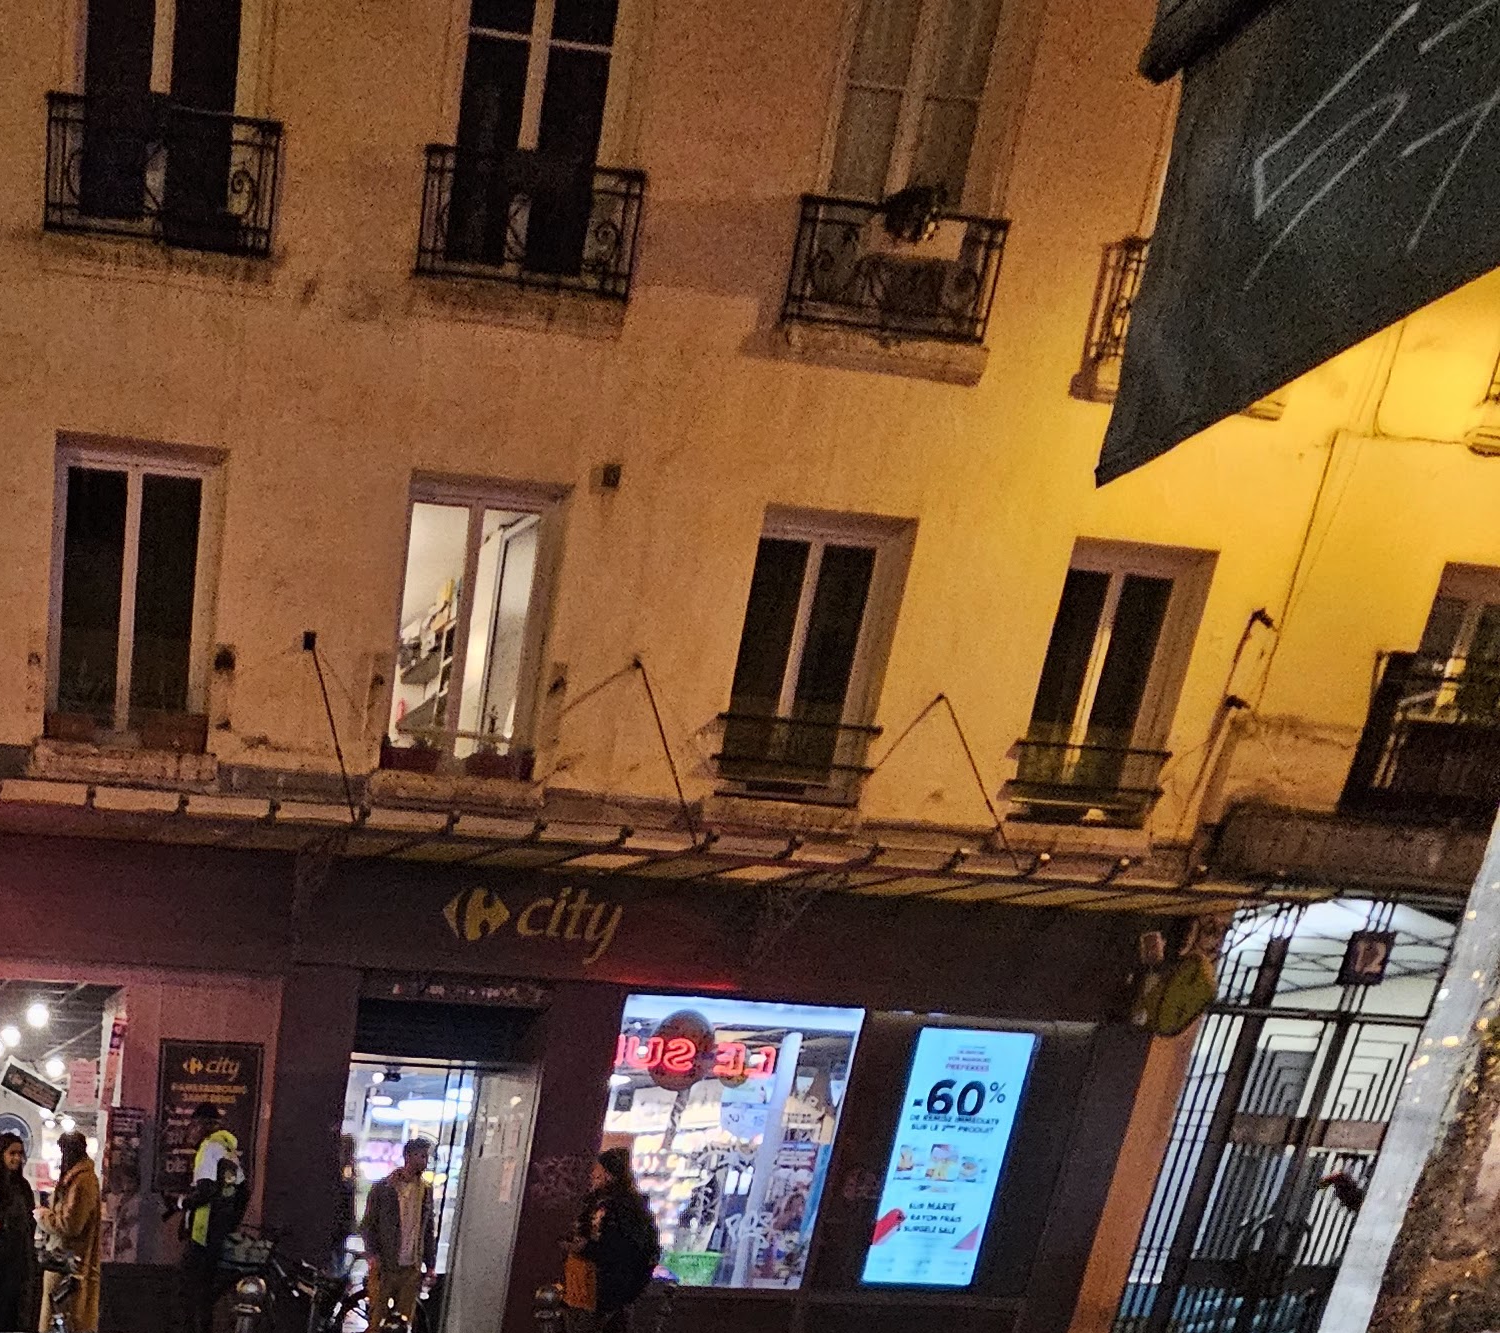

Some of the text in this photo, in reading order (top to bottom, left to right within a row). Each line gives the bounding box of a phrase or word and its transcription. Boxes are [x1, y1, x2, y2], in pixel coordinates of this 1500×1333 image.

[517, 886, 623, 965] city
[1355, 941, 1387, 974] 12
[205, 1056, 240, 1082] city
